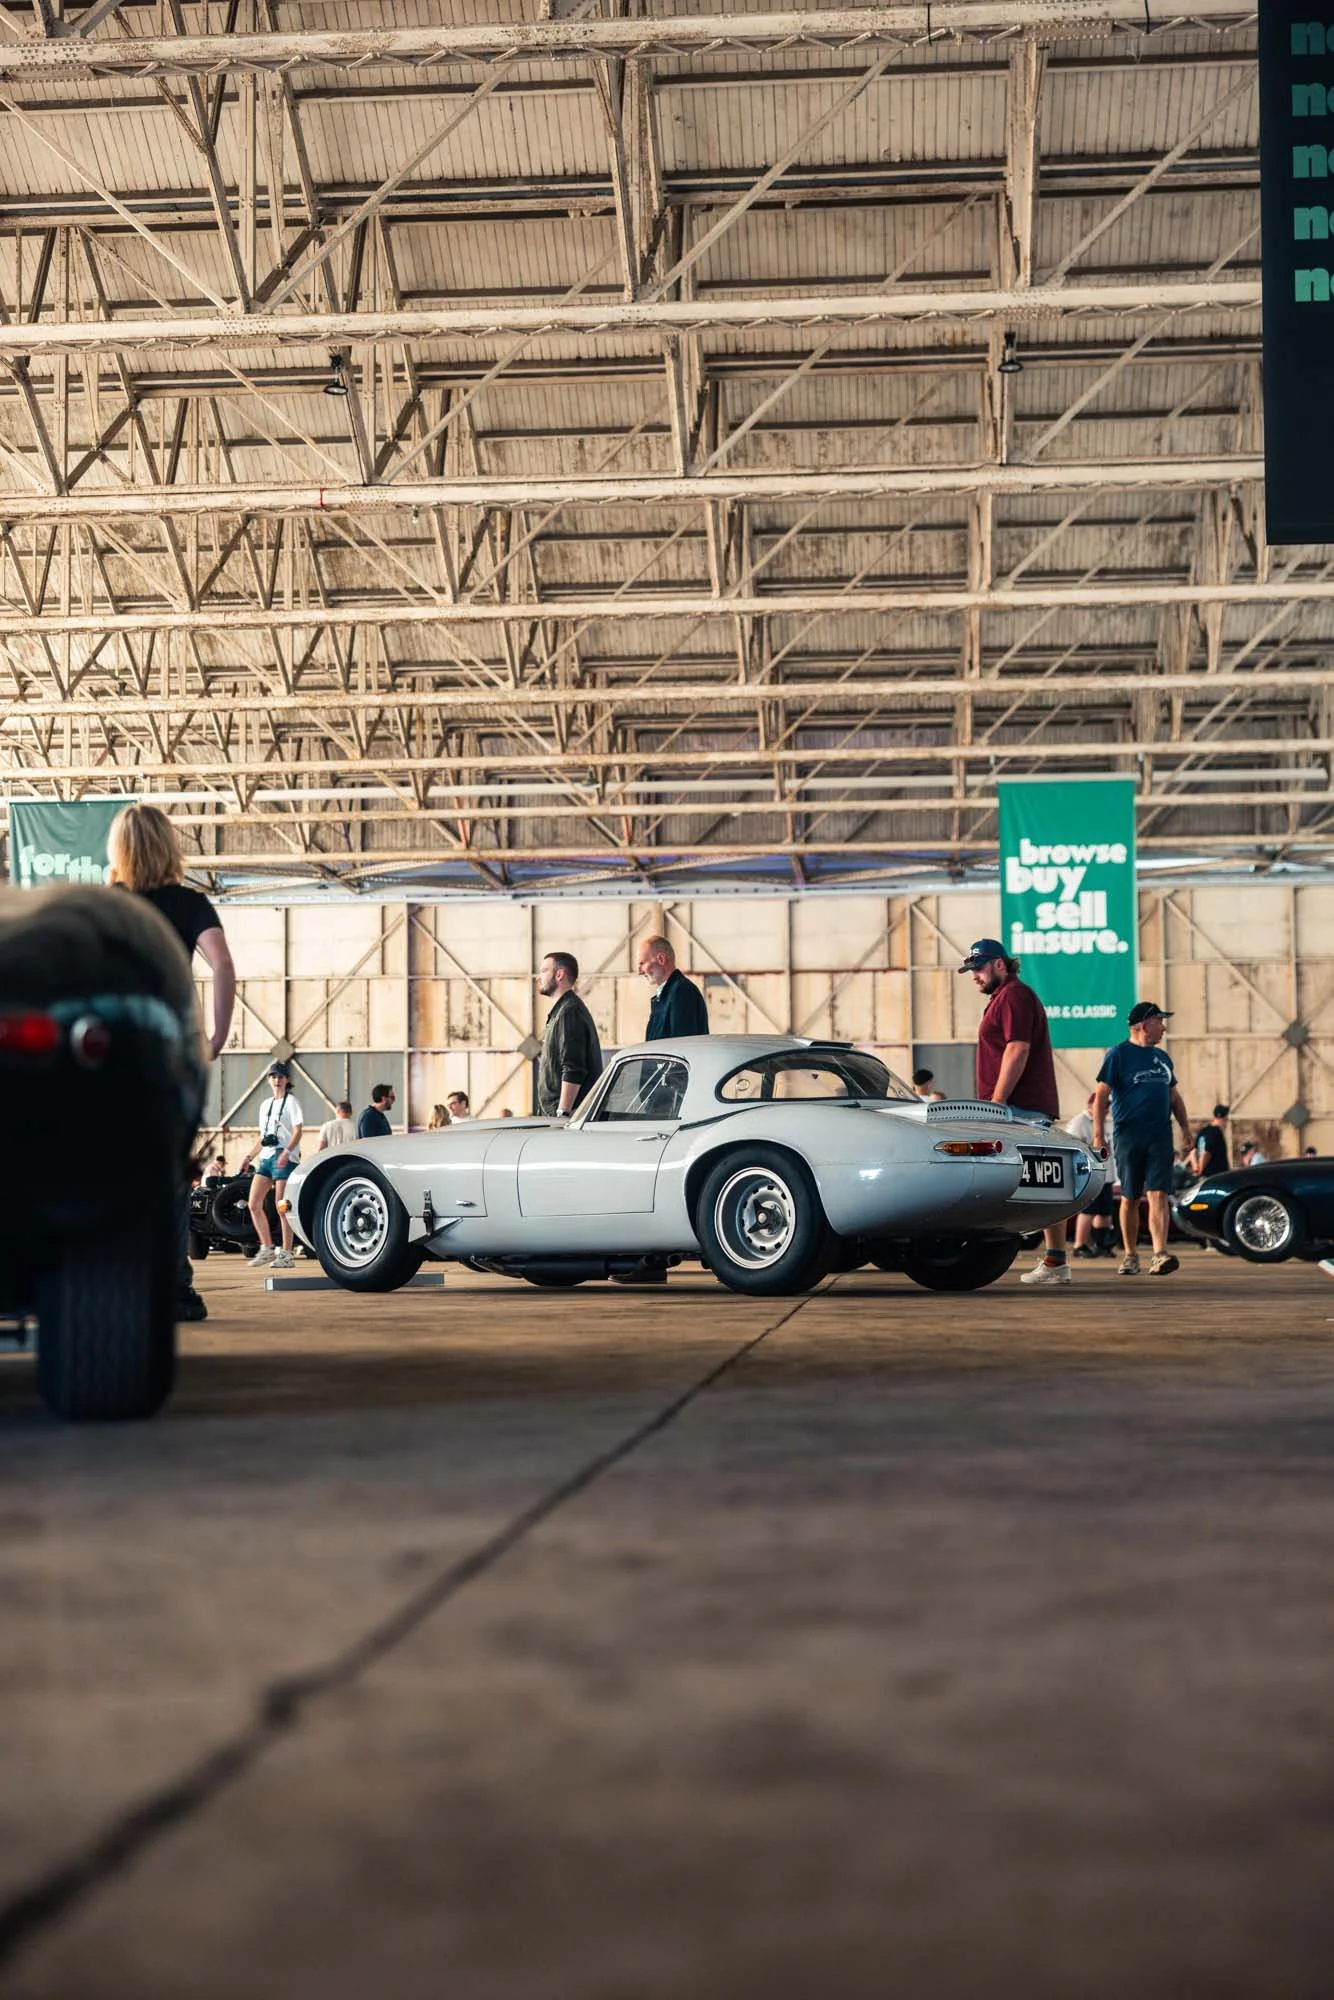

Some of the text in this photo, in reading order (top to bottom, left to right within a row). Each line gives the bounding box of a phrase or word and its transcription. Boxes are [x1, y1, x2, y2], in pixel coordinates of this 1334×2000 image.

[19, 845, 71, 876] for
[1020, 838, 1127, 865] browse
[1005, 857, 1087, 902] buy
[1035, 890, 1107, 929] sell
[1011, 921, 1129, 954] insure.
[1044, 1004, 1117, 1018] AR & CLASSIC
[1022, 1161, 1061, 1183] 4 WPD
